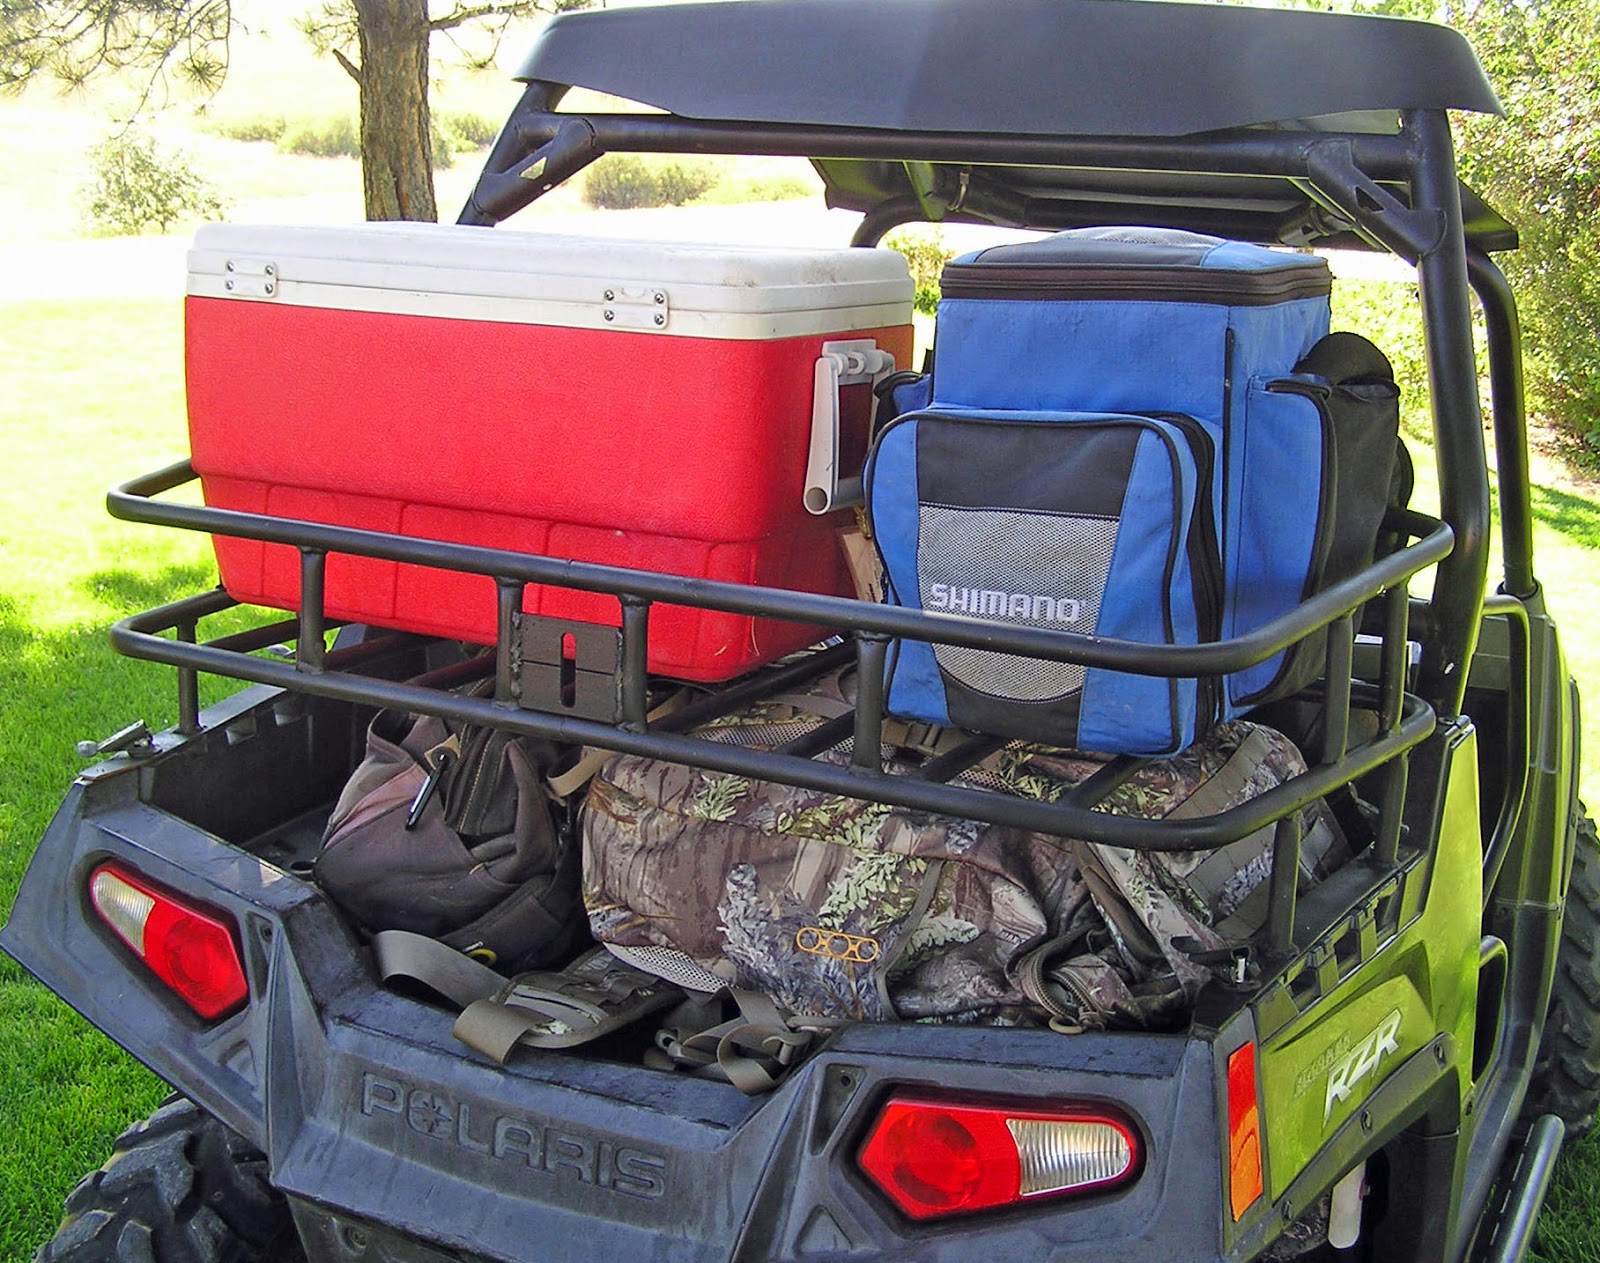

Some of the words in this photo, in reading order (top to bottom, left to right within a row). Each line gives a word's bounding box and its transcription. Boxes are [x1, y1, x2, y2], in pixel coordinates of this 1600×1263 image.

[931, 583, 1080, 622] SHIMANO
[1322, 1007, 1402, 1129] RZR
[361, 1071, 666, 1200] POLARIS
